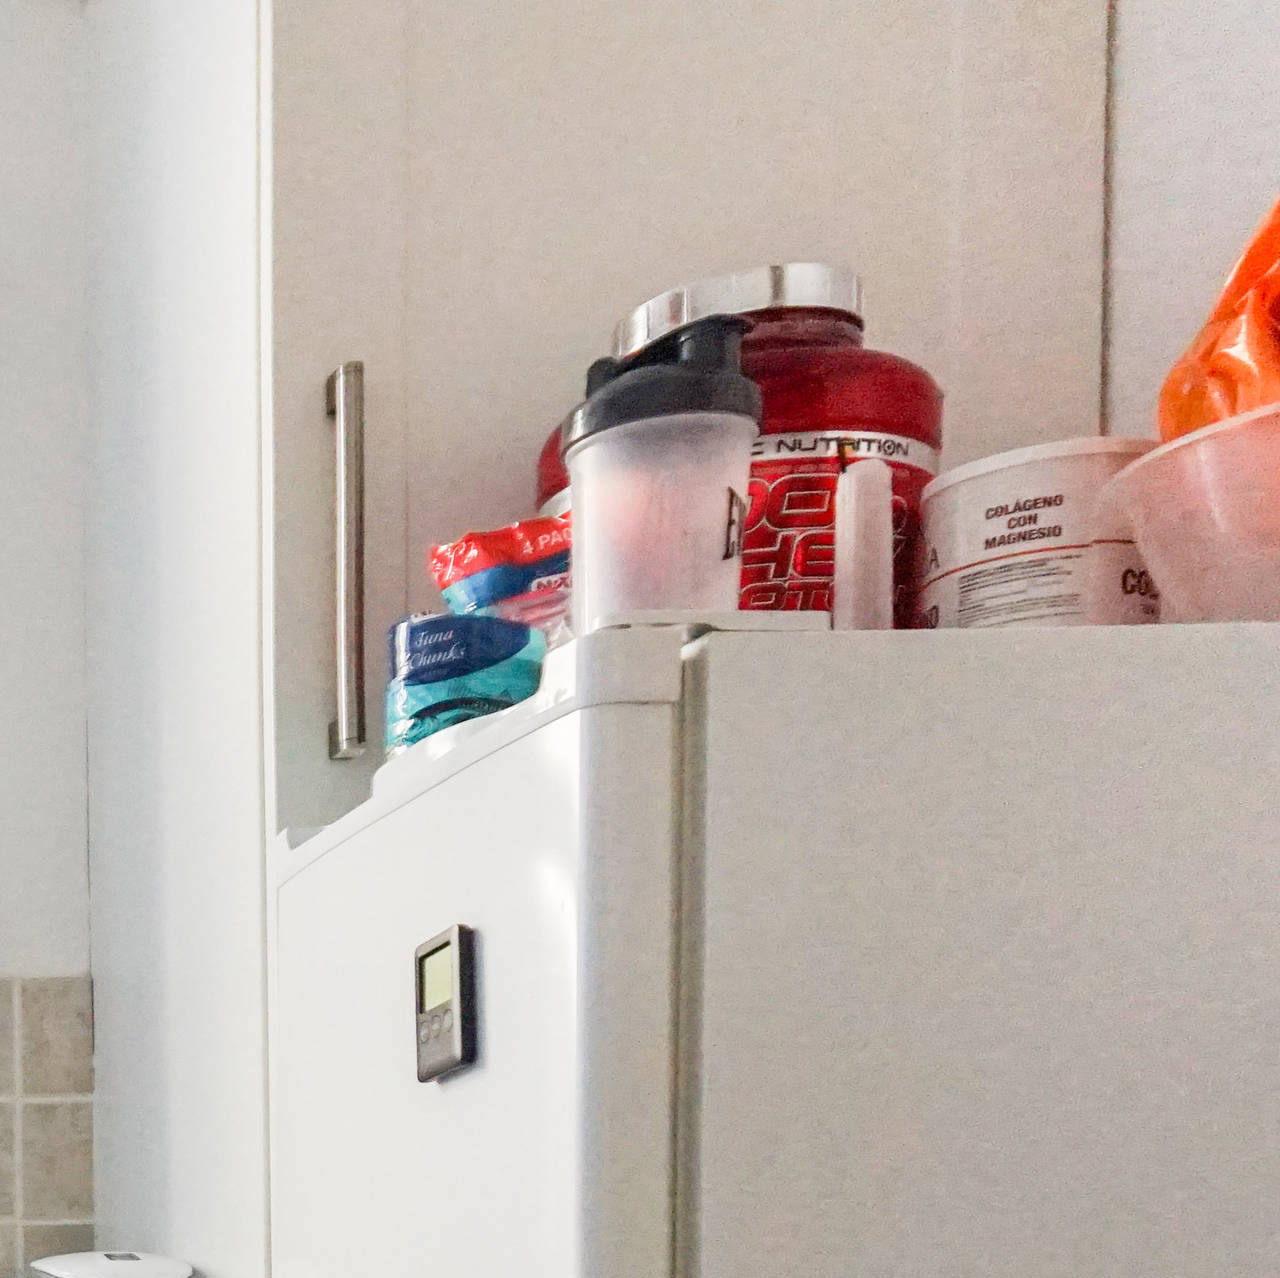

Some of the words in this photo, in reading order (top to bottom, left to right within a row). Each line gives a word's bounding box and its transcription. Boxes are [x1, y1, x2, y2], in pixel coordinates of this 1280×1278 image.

[984, 494, 1065, 520] COLÁGENO
[1007, 513, 1039, 530] CON
[538, 527, 573, 550] PAC
[984, 524, 1063, 550] MAGNESIO
[414, 629, 455, 647] Tuna
